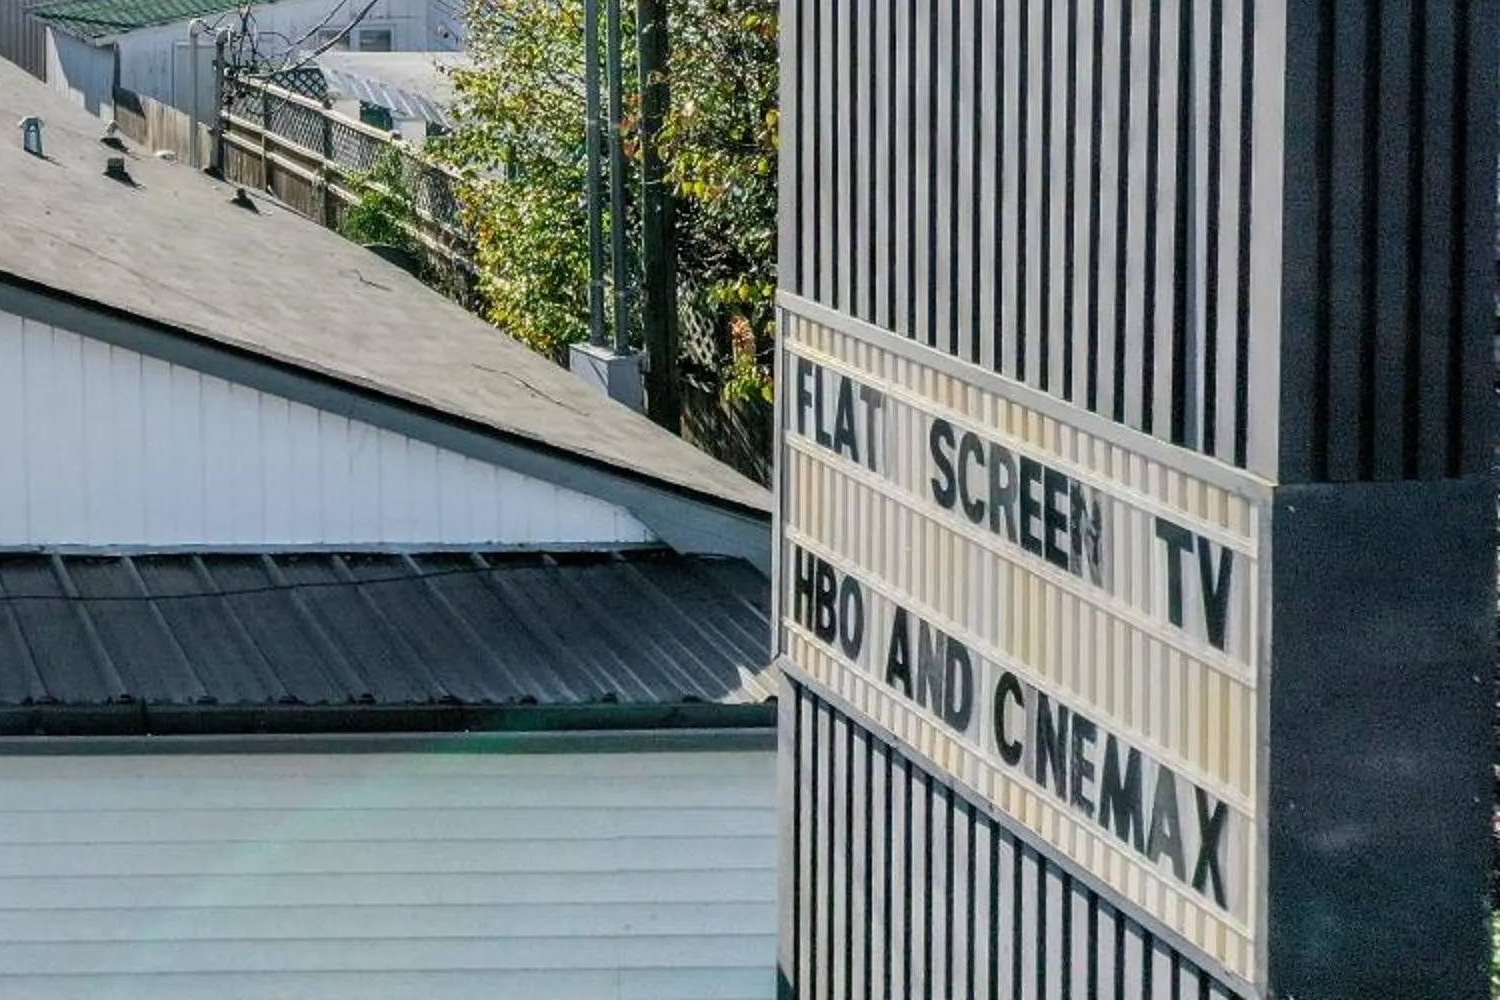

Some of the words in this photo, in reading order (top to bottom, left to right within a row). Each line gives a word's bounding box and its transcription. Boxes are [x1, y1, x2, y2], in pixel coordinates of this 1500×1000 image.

[797, 357, 882, 473] FLAT
[929, 417, 1103, 590] SCREEN
[1155, 515, 1234, 652] TV
[794, 544, 865, 661] HBO
[885, 605, 974, 733] AND
